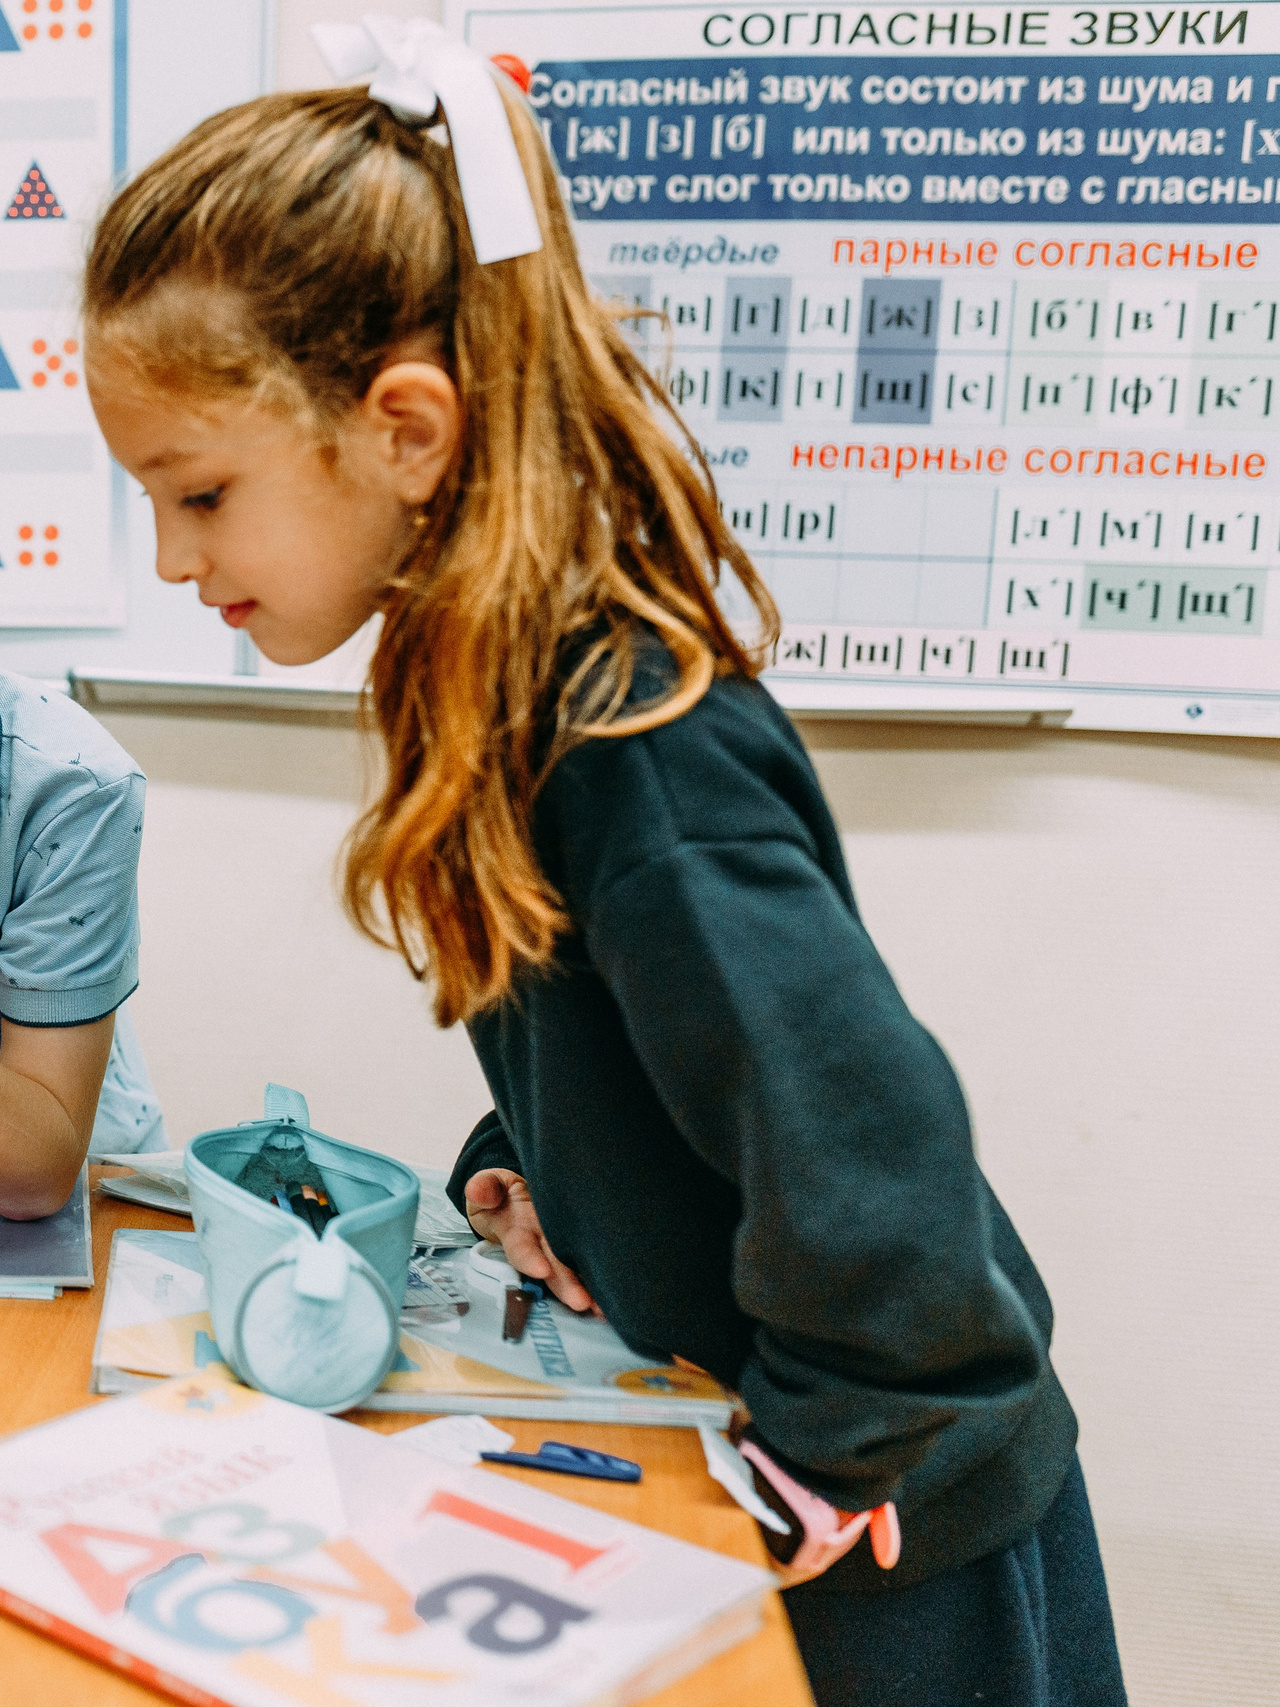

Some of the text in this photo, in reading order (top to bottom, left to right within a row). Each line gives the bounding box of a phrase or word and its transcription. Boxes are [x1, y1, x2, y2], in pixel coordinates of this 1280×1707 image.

[702, 10, 1249, 47] СОГЛАСНЫЕ ЗВУКИ
[528, 68, 749, 109] Согласный
[759, 75, 852, 112] звук
[860, 75, 1029, 105] состоит
[1037, 75, 1087, 104] из
[1098, 75, 1214, 112] шума
[1226, 75, 1254, 103] и
[791, 126, 871, 155] или
[881, 126, 1028, 157] только
[1036, 126, 1087, 156] из
[1096, 126, 1226, 165] шума:
[665, 174, 760, 203] слог
[768, 174, 912, 203] только
[922, 175, 1070, 205] вместе
[1080, 176, 1106, 204] с
[1117, 175, 1280, 205] гласны
[609, 234, 781, 270] твёрдые
[833, 239, 1259, 275] парные согласные
[791, 444, 1266, 480] непарные согласные
